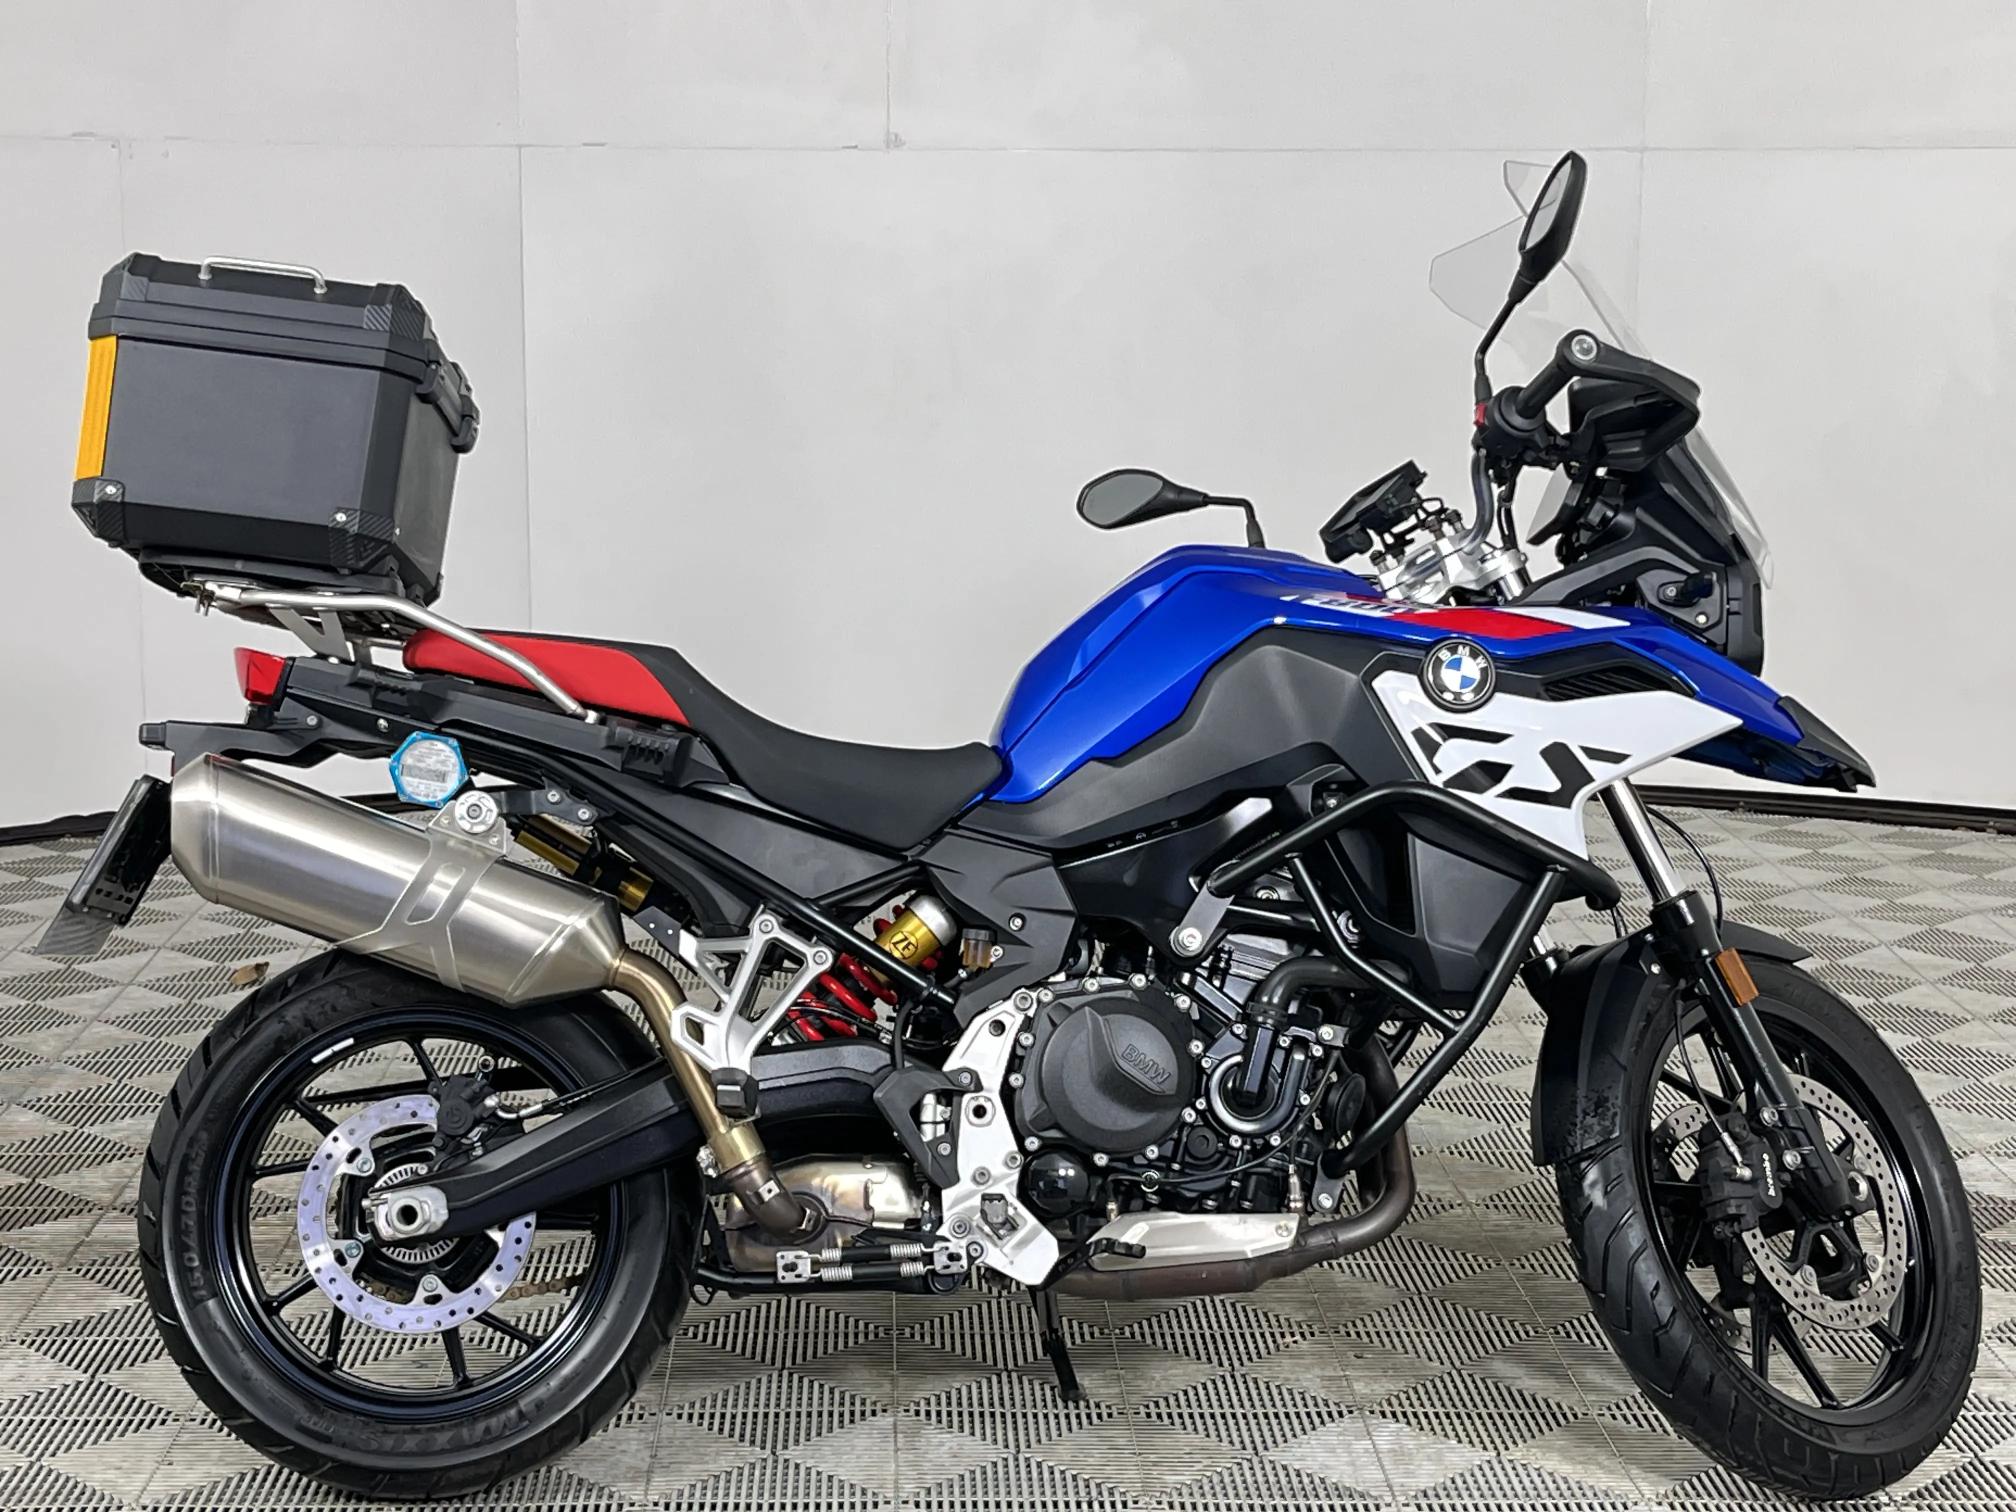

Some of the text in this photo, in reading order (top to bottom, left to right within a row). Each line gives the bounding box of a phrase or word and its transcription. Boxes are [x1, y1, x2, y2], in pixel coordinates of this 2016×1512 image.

[1438, 645, 1487, 668] BMW
[891, 931, 918, 959] ZF
[1121, 1043, 1171, 1085] BMW
